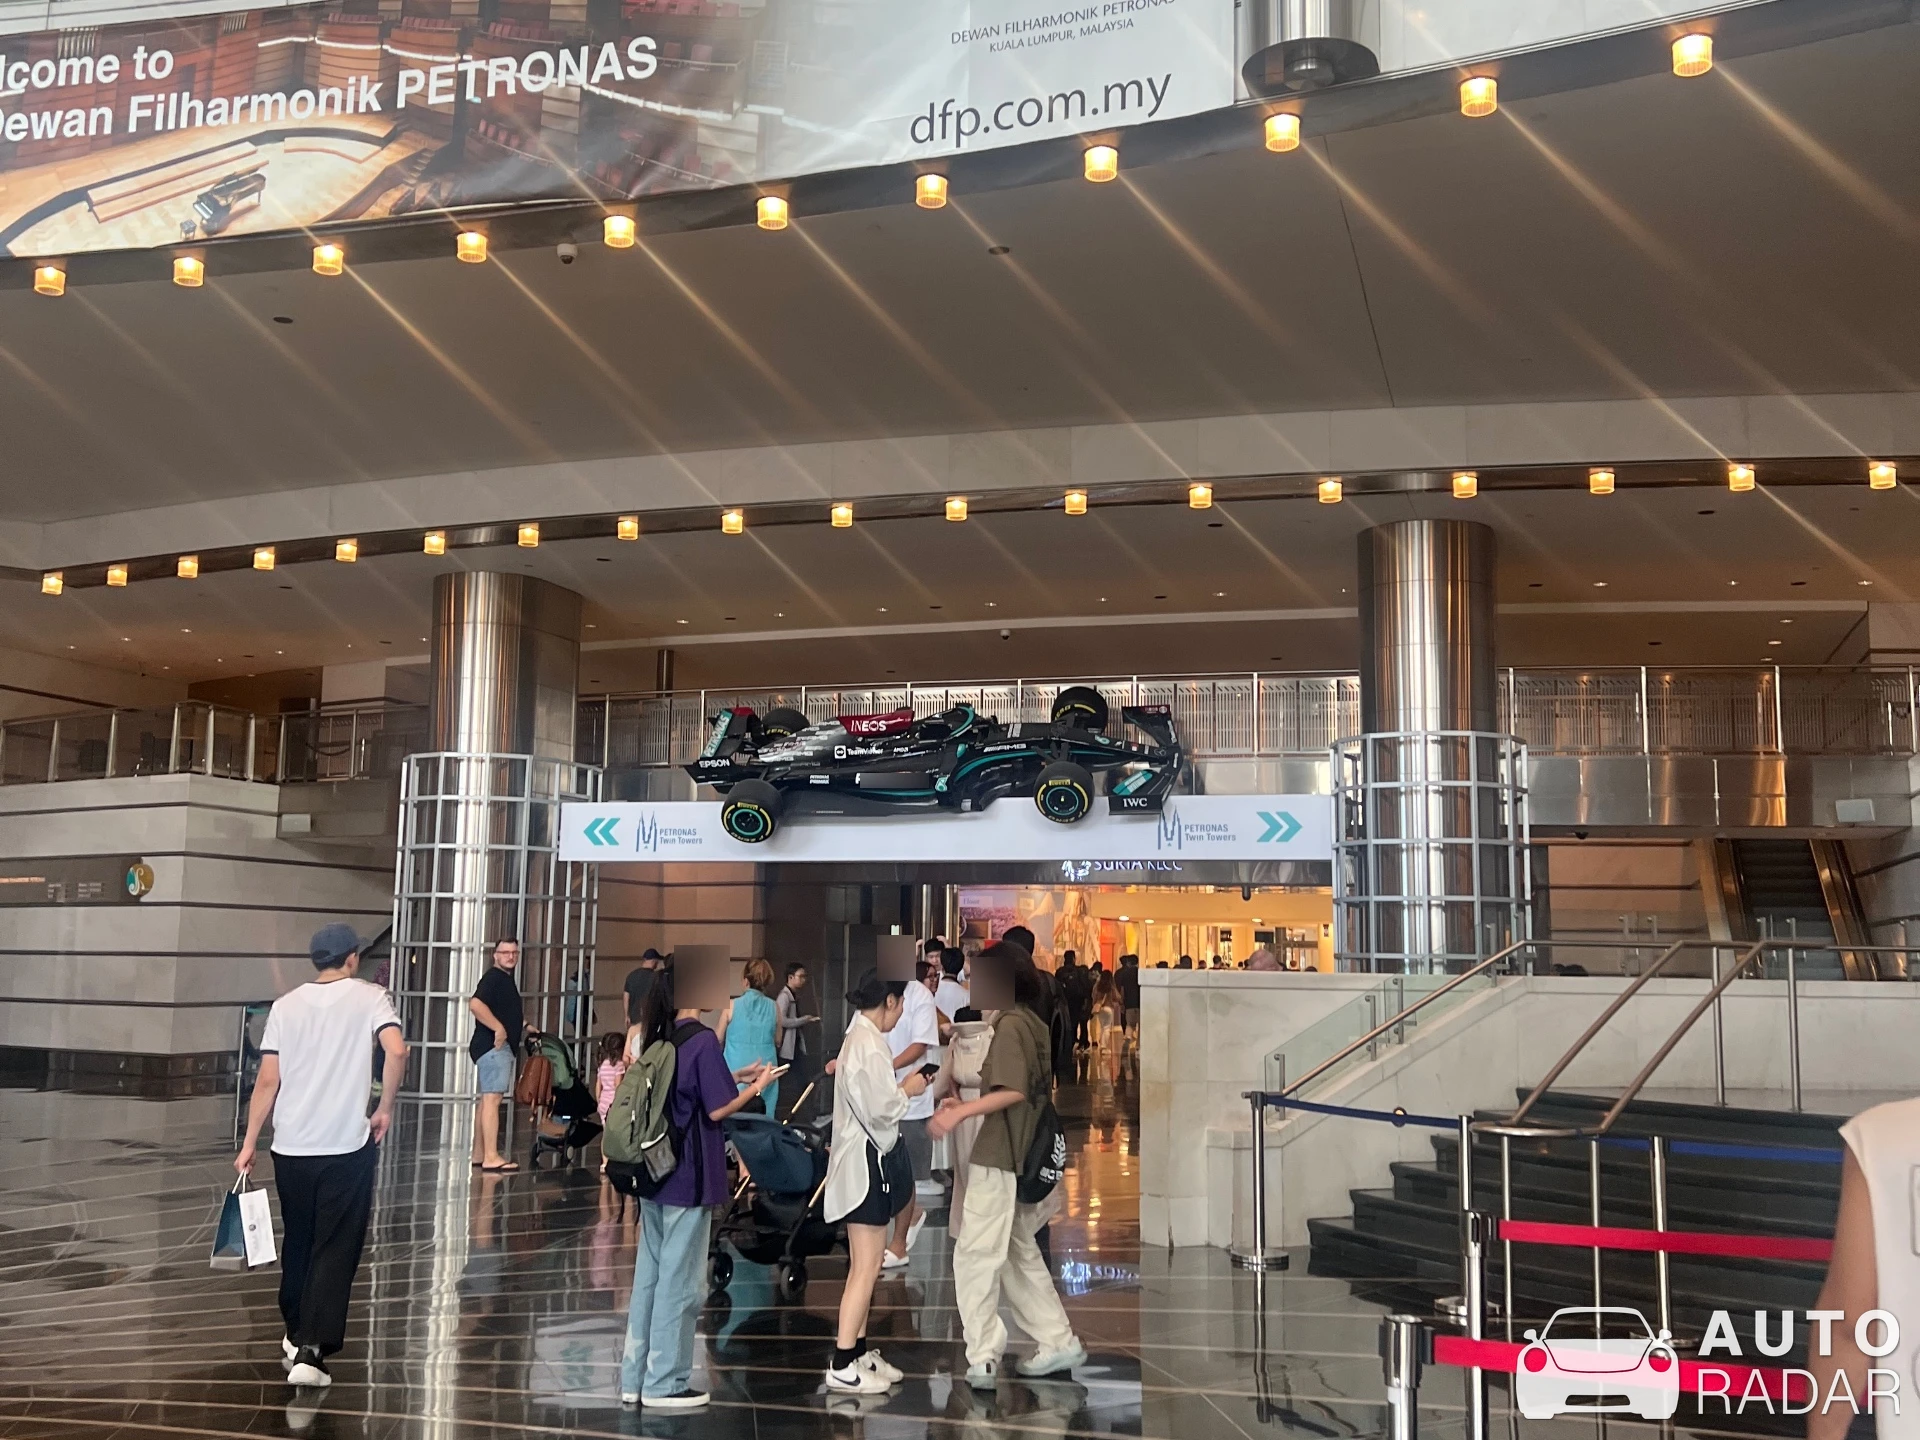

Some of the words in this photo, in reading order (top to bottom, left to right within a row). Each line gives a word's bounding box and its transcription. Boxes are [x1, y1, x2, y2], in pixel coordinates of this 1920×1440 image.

[951, 25, 1000, 44] DEWAN
[1005, 6, 1098, 34] FILHARMONIK
[1103, 0, 1175, 17] PETRON
[990, 38, 1025, 53] KUALA
[1027, 30, 1076, 47] LUMPUR,
[1080, 18, 1134, 37] MALAYSIA
[133, 45, 174, 83] to
[0, 106, 113, 142] ewan
[128, 75, 383, 133] Filharmonik
[396, 36, 658, 108] PETRONAS
[910, 73, 1172, 148] dfp.com.my
[851, 720, 887, 732] INEOS
[699, 759, 730, 768] EPSON
[1123, 797, 1148, 807] IWC
[660, 828, 697, 836] PETRONAS
[1184, 824, 1229, 832] PETRONAS
[1185, 833, 1204, 841] Twin
[1206, 833, 1236, 841] Towers
